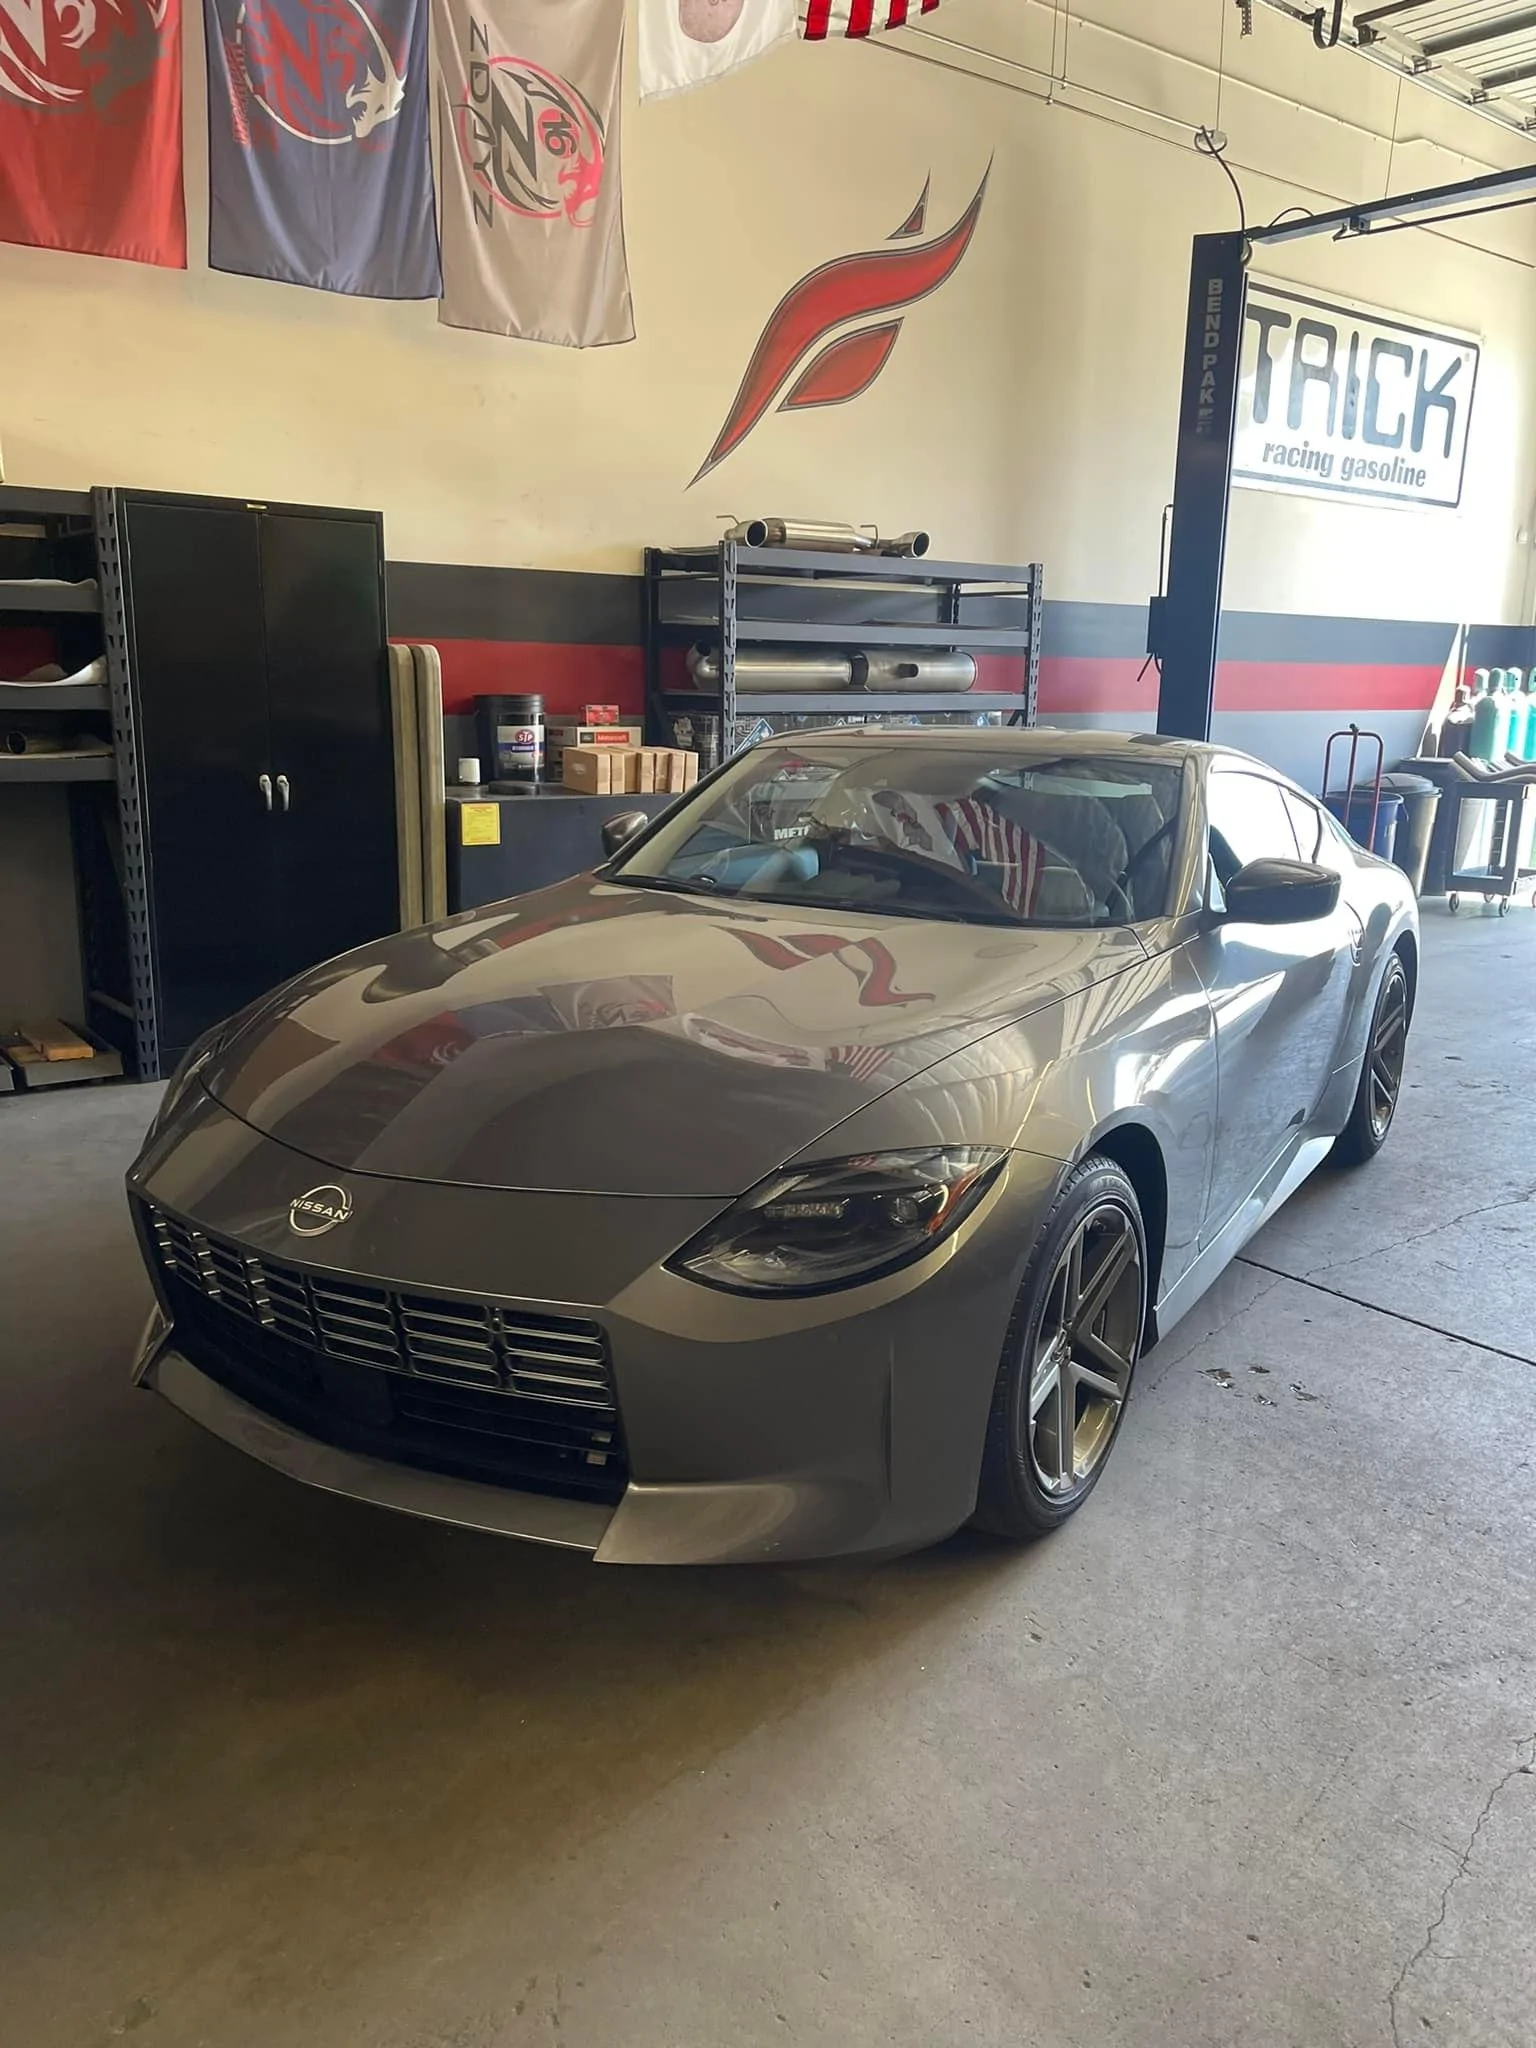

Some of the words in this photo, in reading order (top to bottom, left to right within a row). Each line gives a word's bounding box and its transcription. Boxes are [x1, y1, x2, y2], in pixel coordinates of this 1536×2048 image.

[1245, 304, 1462, 459] TRICK
[1262, 441, 1335, 478] racing
[1341, 456, 1427, 488] gasoline
[518, 731, 533, 743] STP
[290, 1199, 349, 1220] NISSAN
